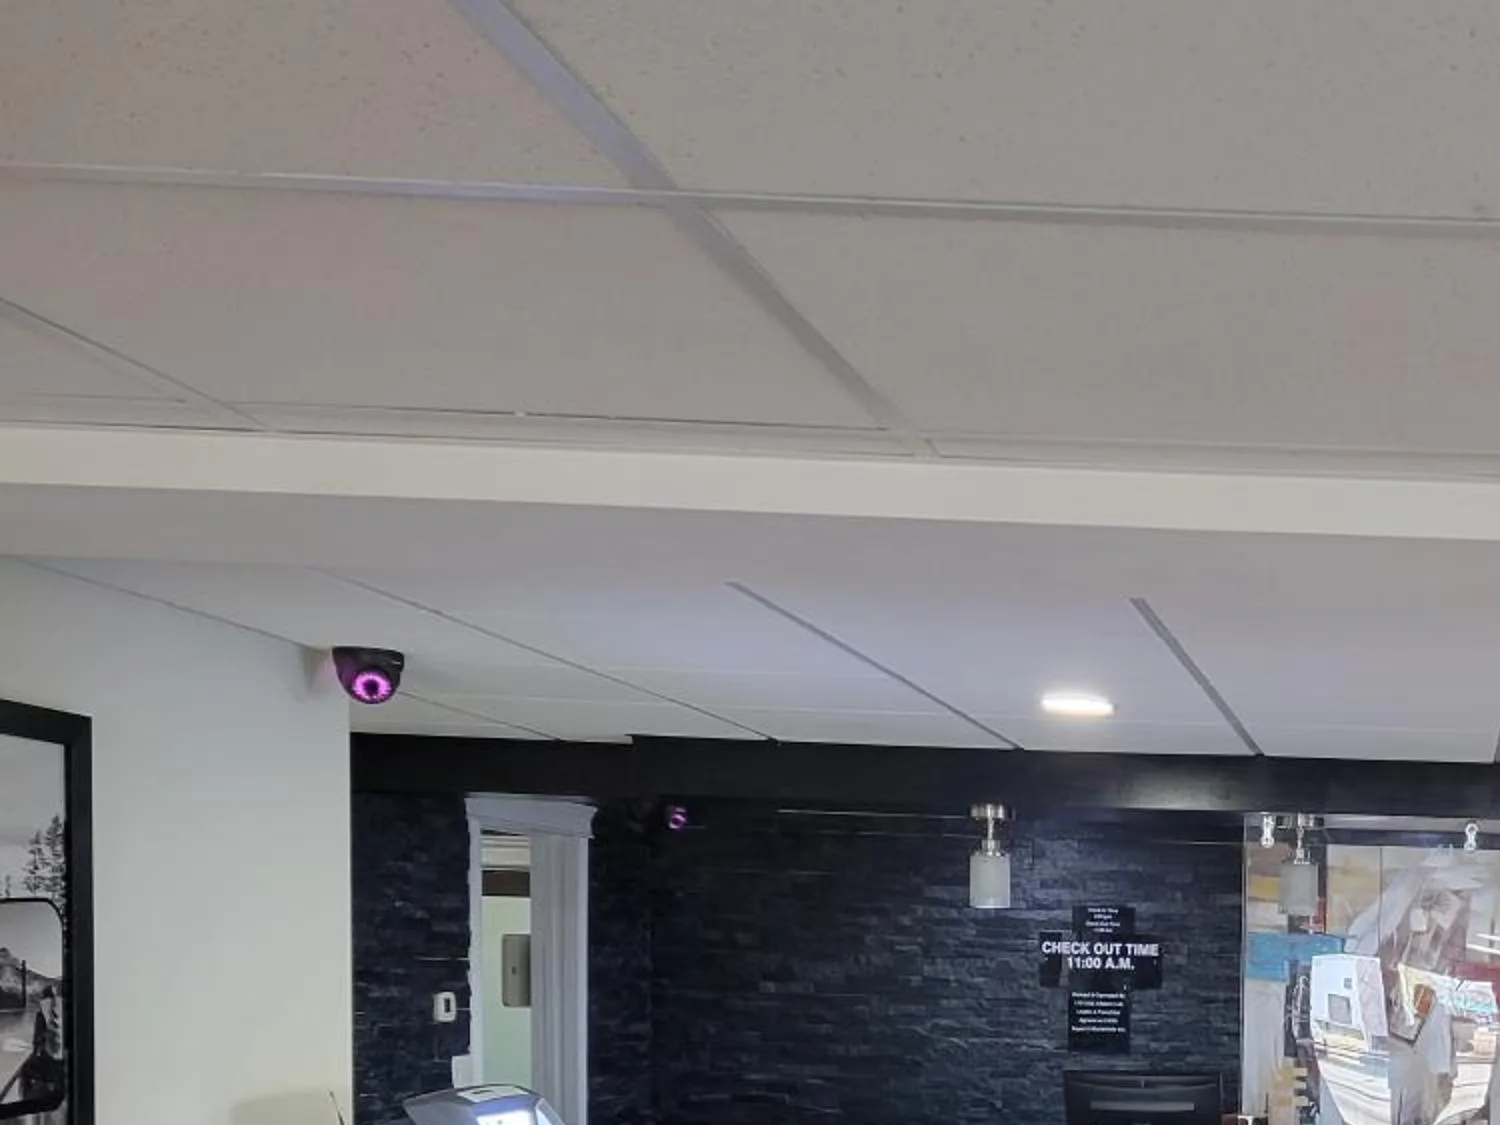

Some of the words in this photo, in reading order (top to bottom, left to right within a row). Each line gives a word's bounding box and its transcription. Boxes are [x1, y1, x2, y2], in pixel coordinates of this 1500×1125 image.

[1041, 941, 1090, 955] CHECK
[1093, 943, 1122, 956] OUT
[1125, 943, 1159, 957] TIME
[1067, 956, 1101, 970] 11:00
[1105, 957, 1135, 971] A.M.
